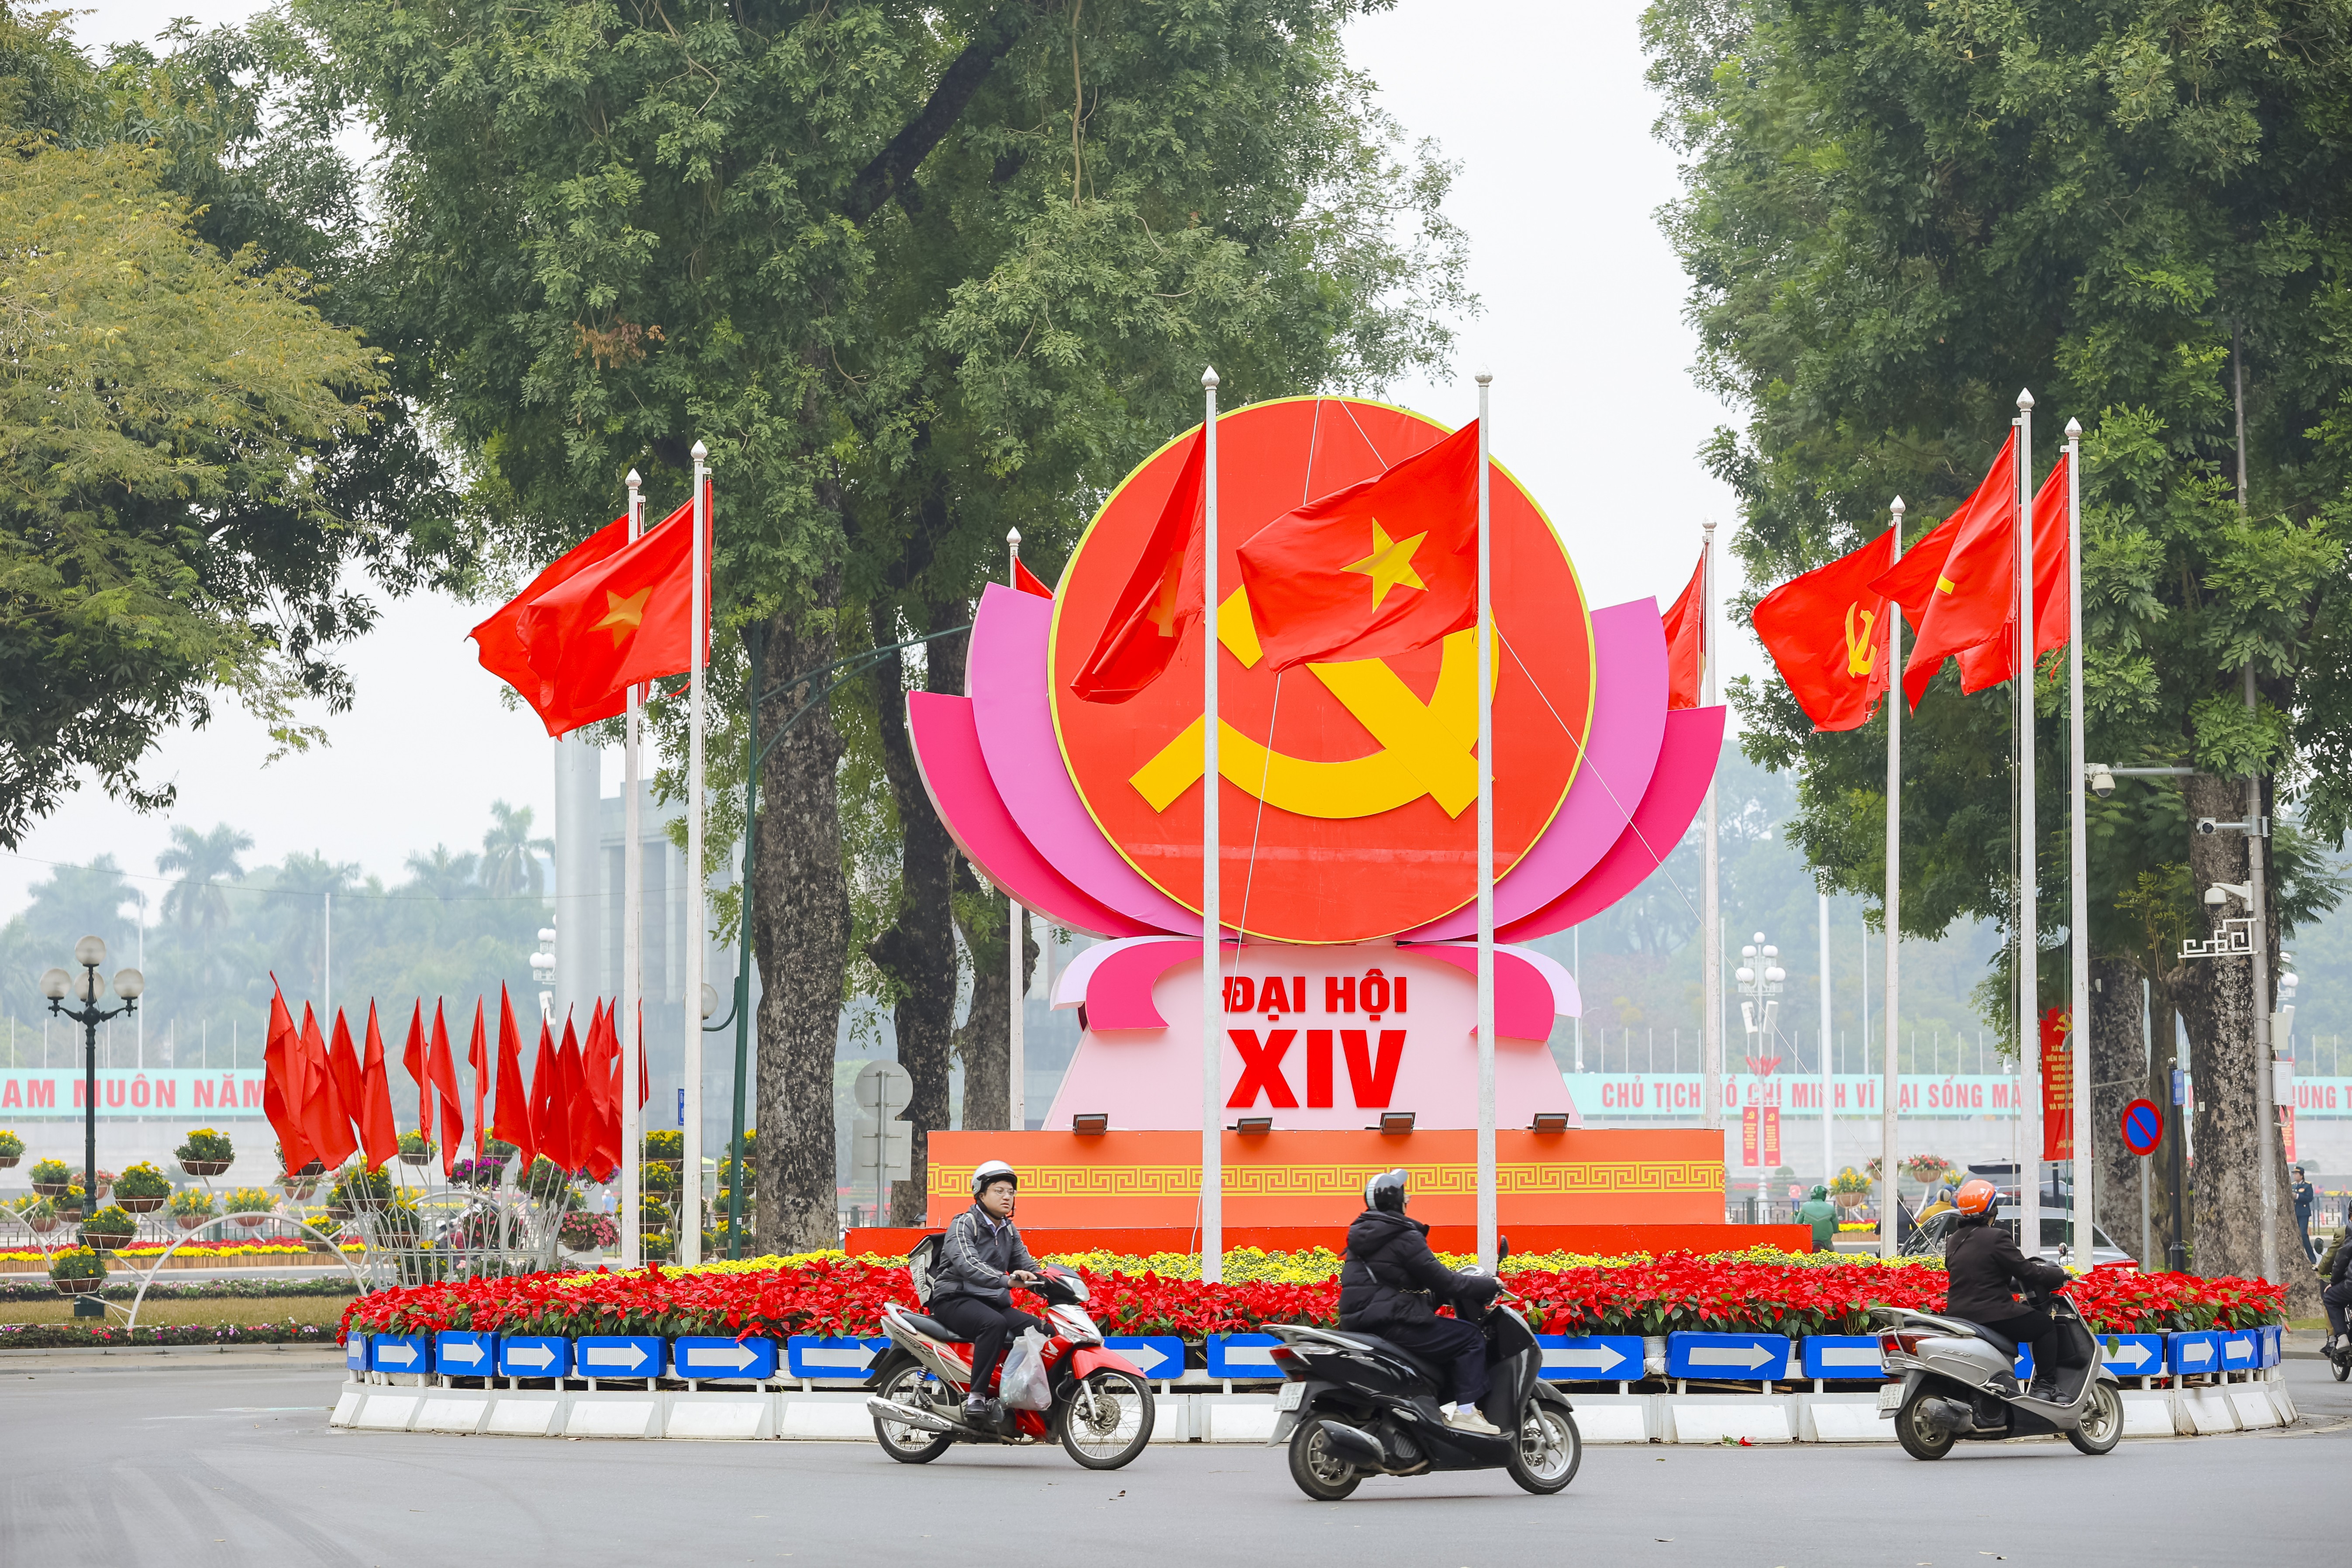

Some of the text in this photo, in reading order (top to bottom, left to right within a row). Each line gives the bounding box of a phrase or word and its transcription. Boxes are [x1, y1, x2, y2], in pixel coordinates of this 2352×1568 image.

[1222, 969, 1407, 1021] ĐẠI HỘI
[1226, 1030, 1407, 1108] XIV
[73, 1073, 176, 1108] MUÔN
[193, 1073, 266, 1108] NĂM
[1602, 1075, 1644, 1108] CHỦ
[1654, 1082, 1700, 1113] TỊCH
[1856, 1079, 1875, 1108] VĨ
[1928, 1075, 1983, 1108] SỐNG
[1992, 1079, 2021, 1108] MÃ
[1878, 1396, 1900, 1409] 295.24
[1882, 1385, 1901, 1397] 29-E1
